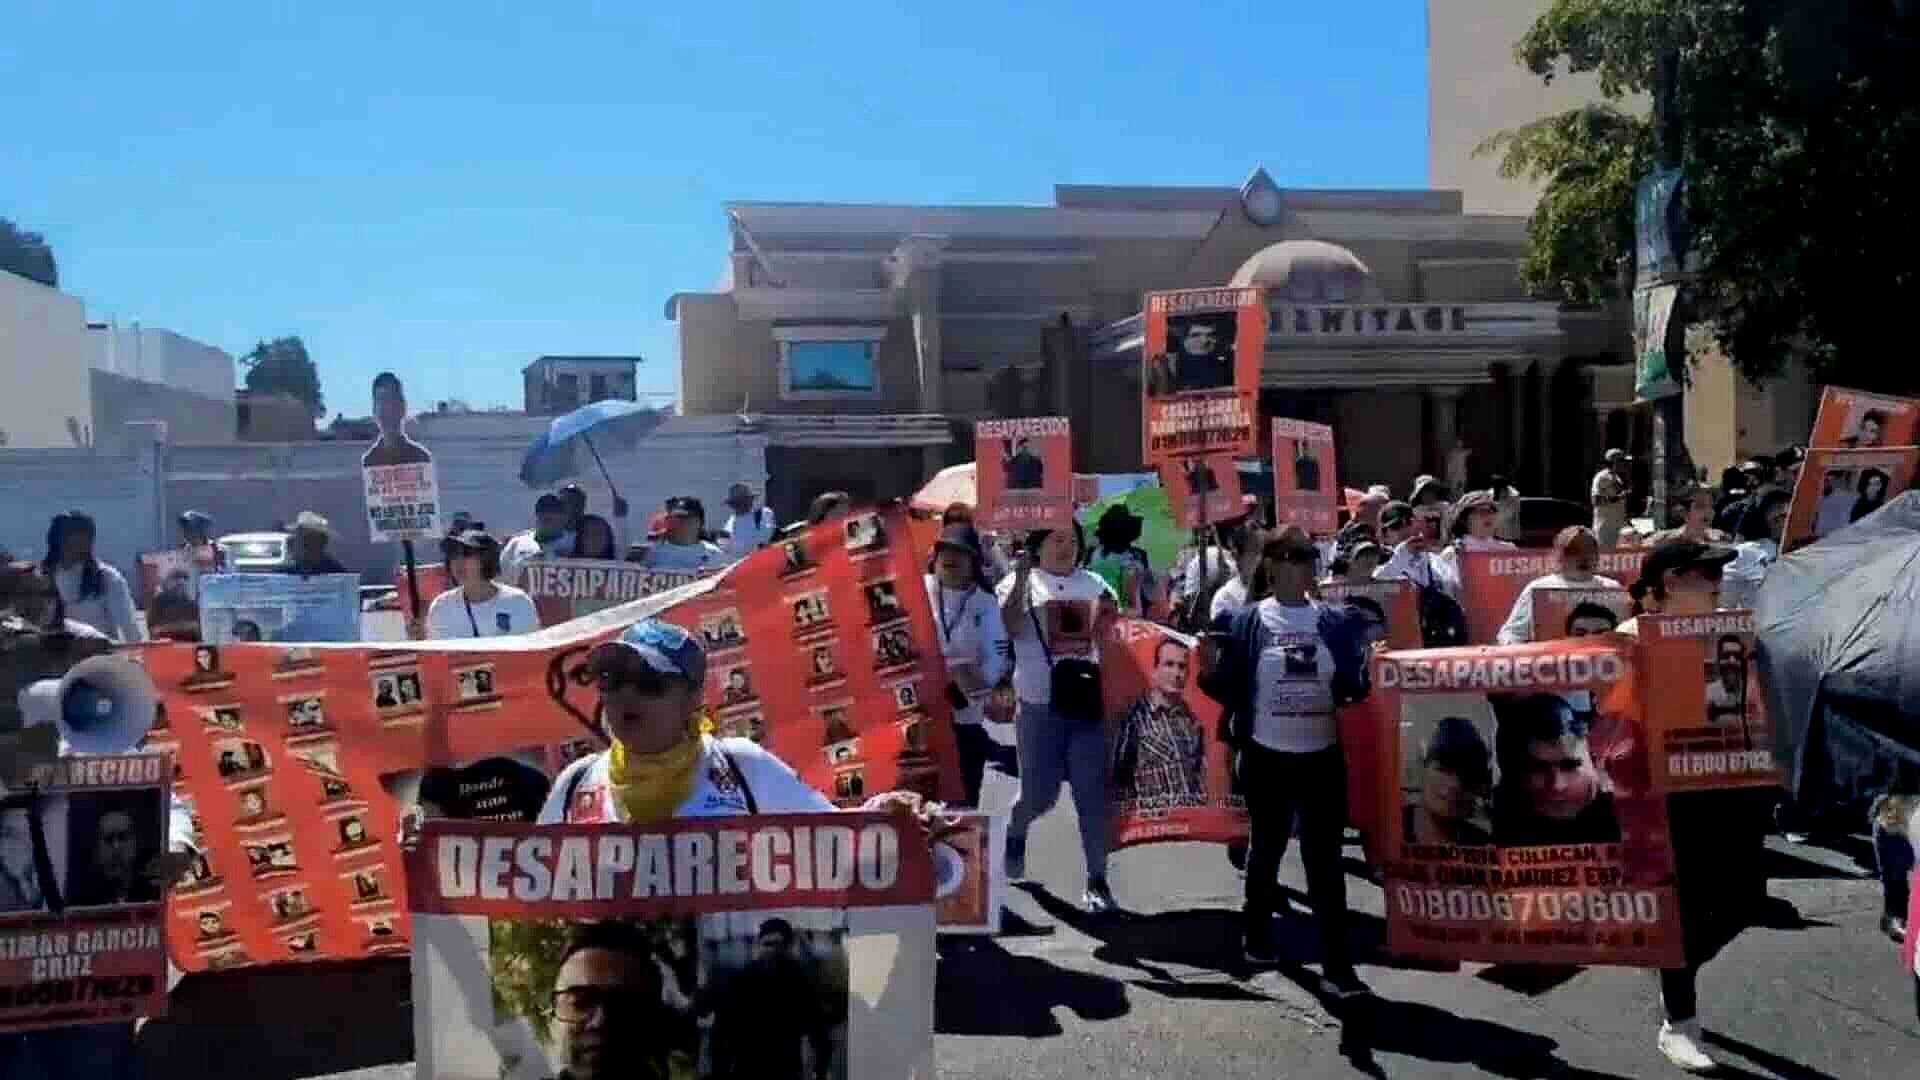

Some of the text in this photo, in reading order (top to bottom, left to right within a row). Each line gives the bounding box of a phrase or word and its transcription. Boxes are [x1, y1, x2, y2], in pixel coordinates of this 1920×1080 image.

[977, 417, 1069, 438] DESAPARECIDO
[1379, 656, 1625, 690] DESAPARECIDO
[437, 824, 898, 901] DESAPARECIDO
[1398, 886, 1658, 924] 018006703600
[31, 954, 93, 983] CRUZ
